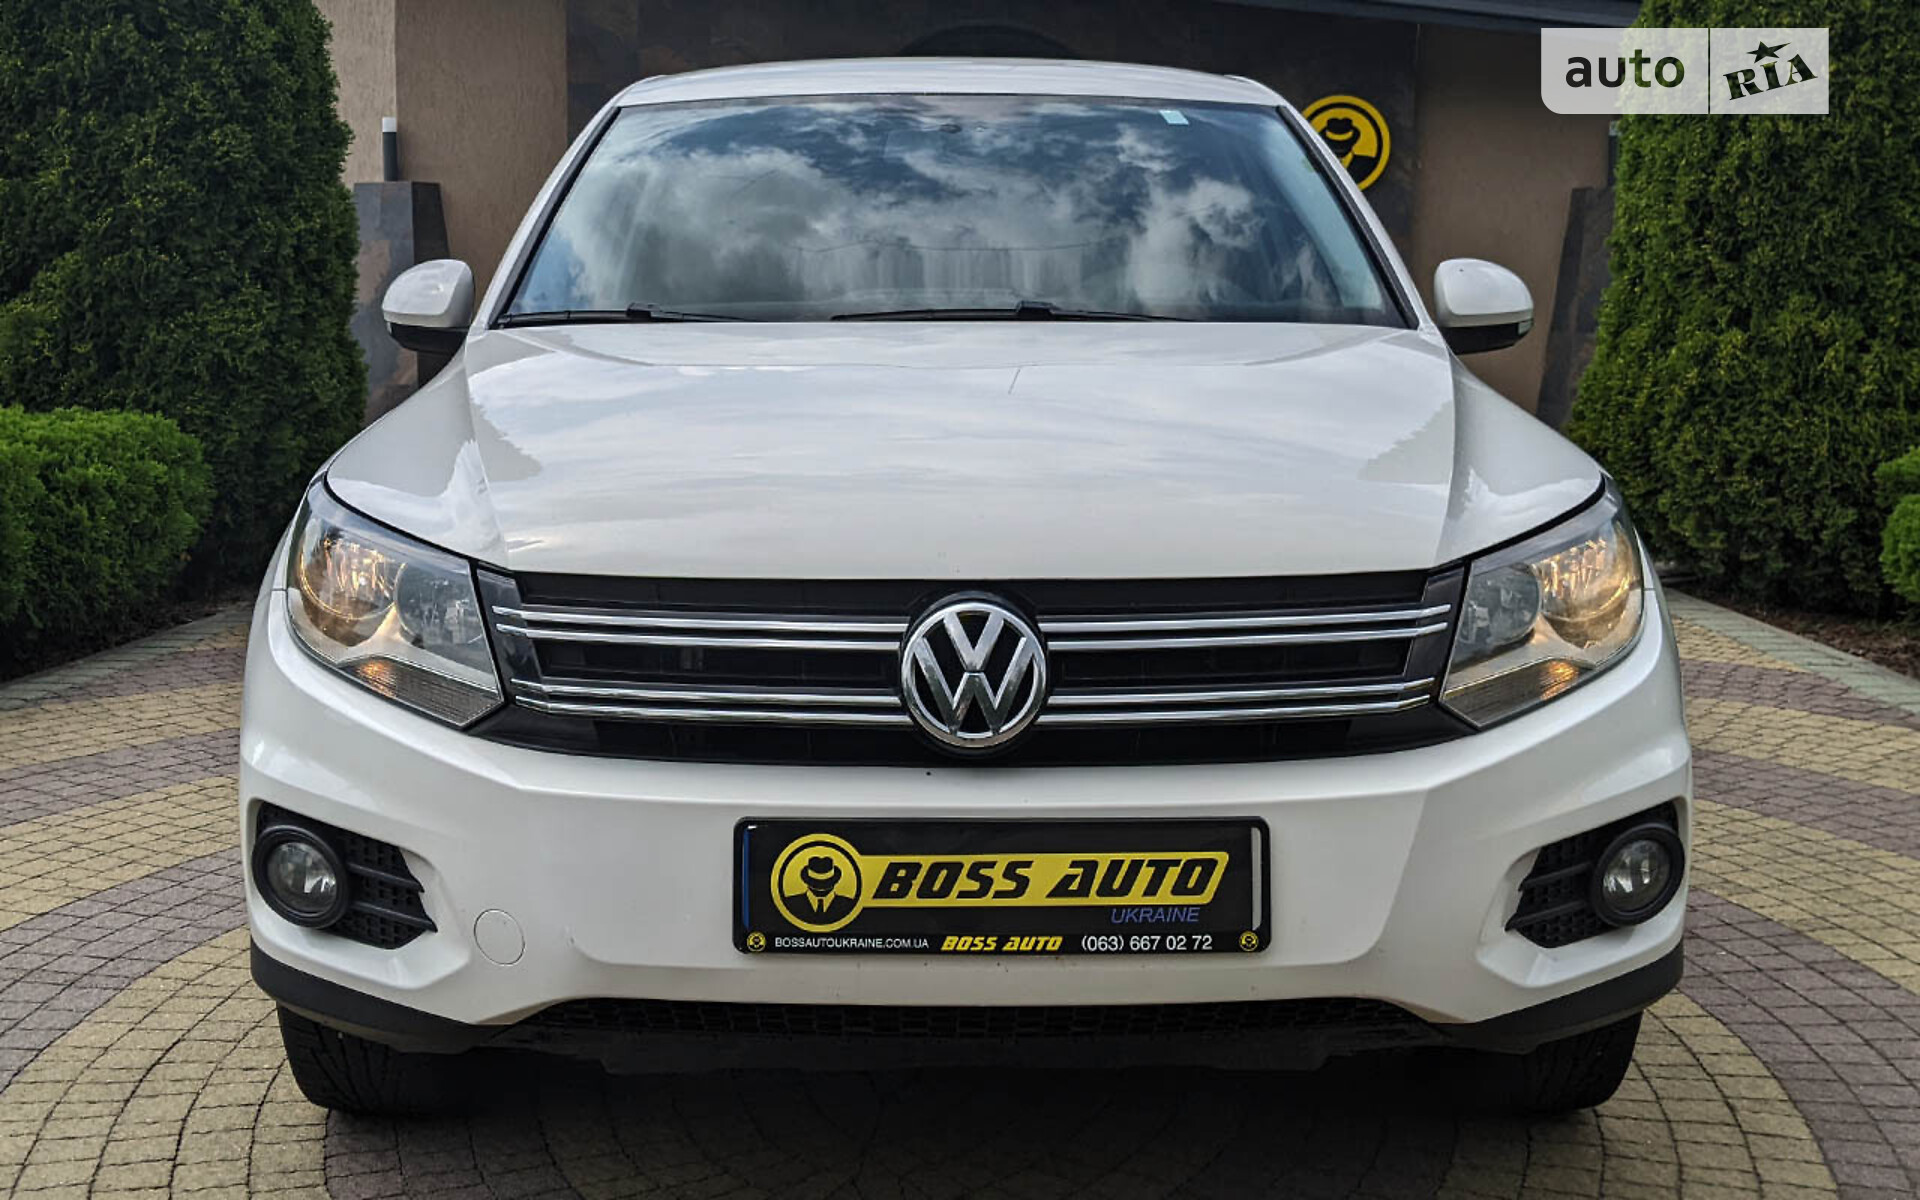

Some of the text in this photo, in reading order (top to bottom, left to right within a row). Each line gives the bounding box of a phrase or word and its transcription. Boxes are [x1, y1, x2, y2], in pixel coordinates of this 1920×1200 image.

[911, 609, 1038, 737] VW
[872, 857, 1219, 900] BOSS AUTO
[1110, 907, 1201, 924] UKRAINE
[774, 937, 929, 949] BOSSAUTOUKRAINE.COM.UA
[940, 935, 1064, 951] BOSS AUTO
[1081, 934, 1213, 951] (063) 667 02 72
